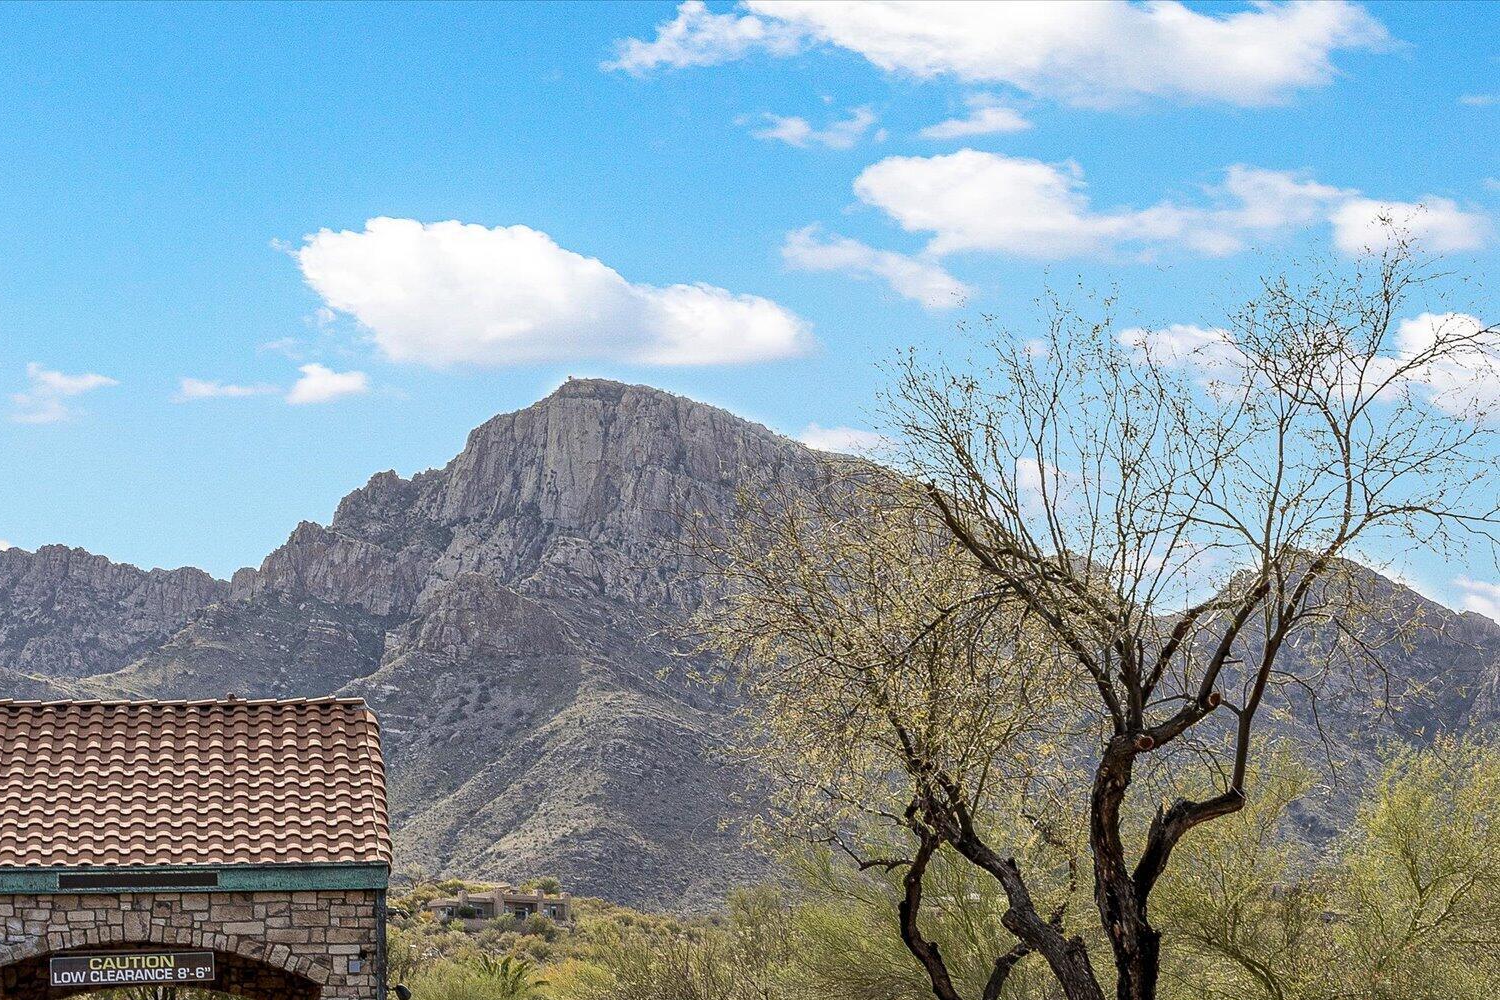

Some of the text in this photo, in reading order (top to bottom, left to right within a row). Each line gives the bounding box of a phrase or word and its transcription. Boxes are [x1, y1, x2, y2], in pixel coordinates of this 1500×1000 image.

[89, 955, 175, 970] CAUTION
[53, 971, 86, 984] LOW
[90, 968, 173, 983] CLEARANCE
